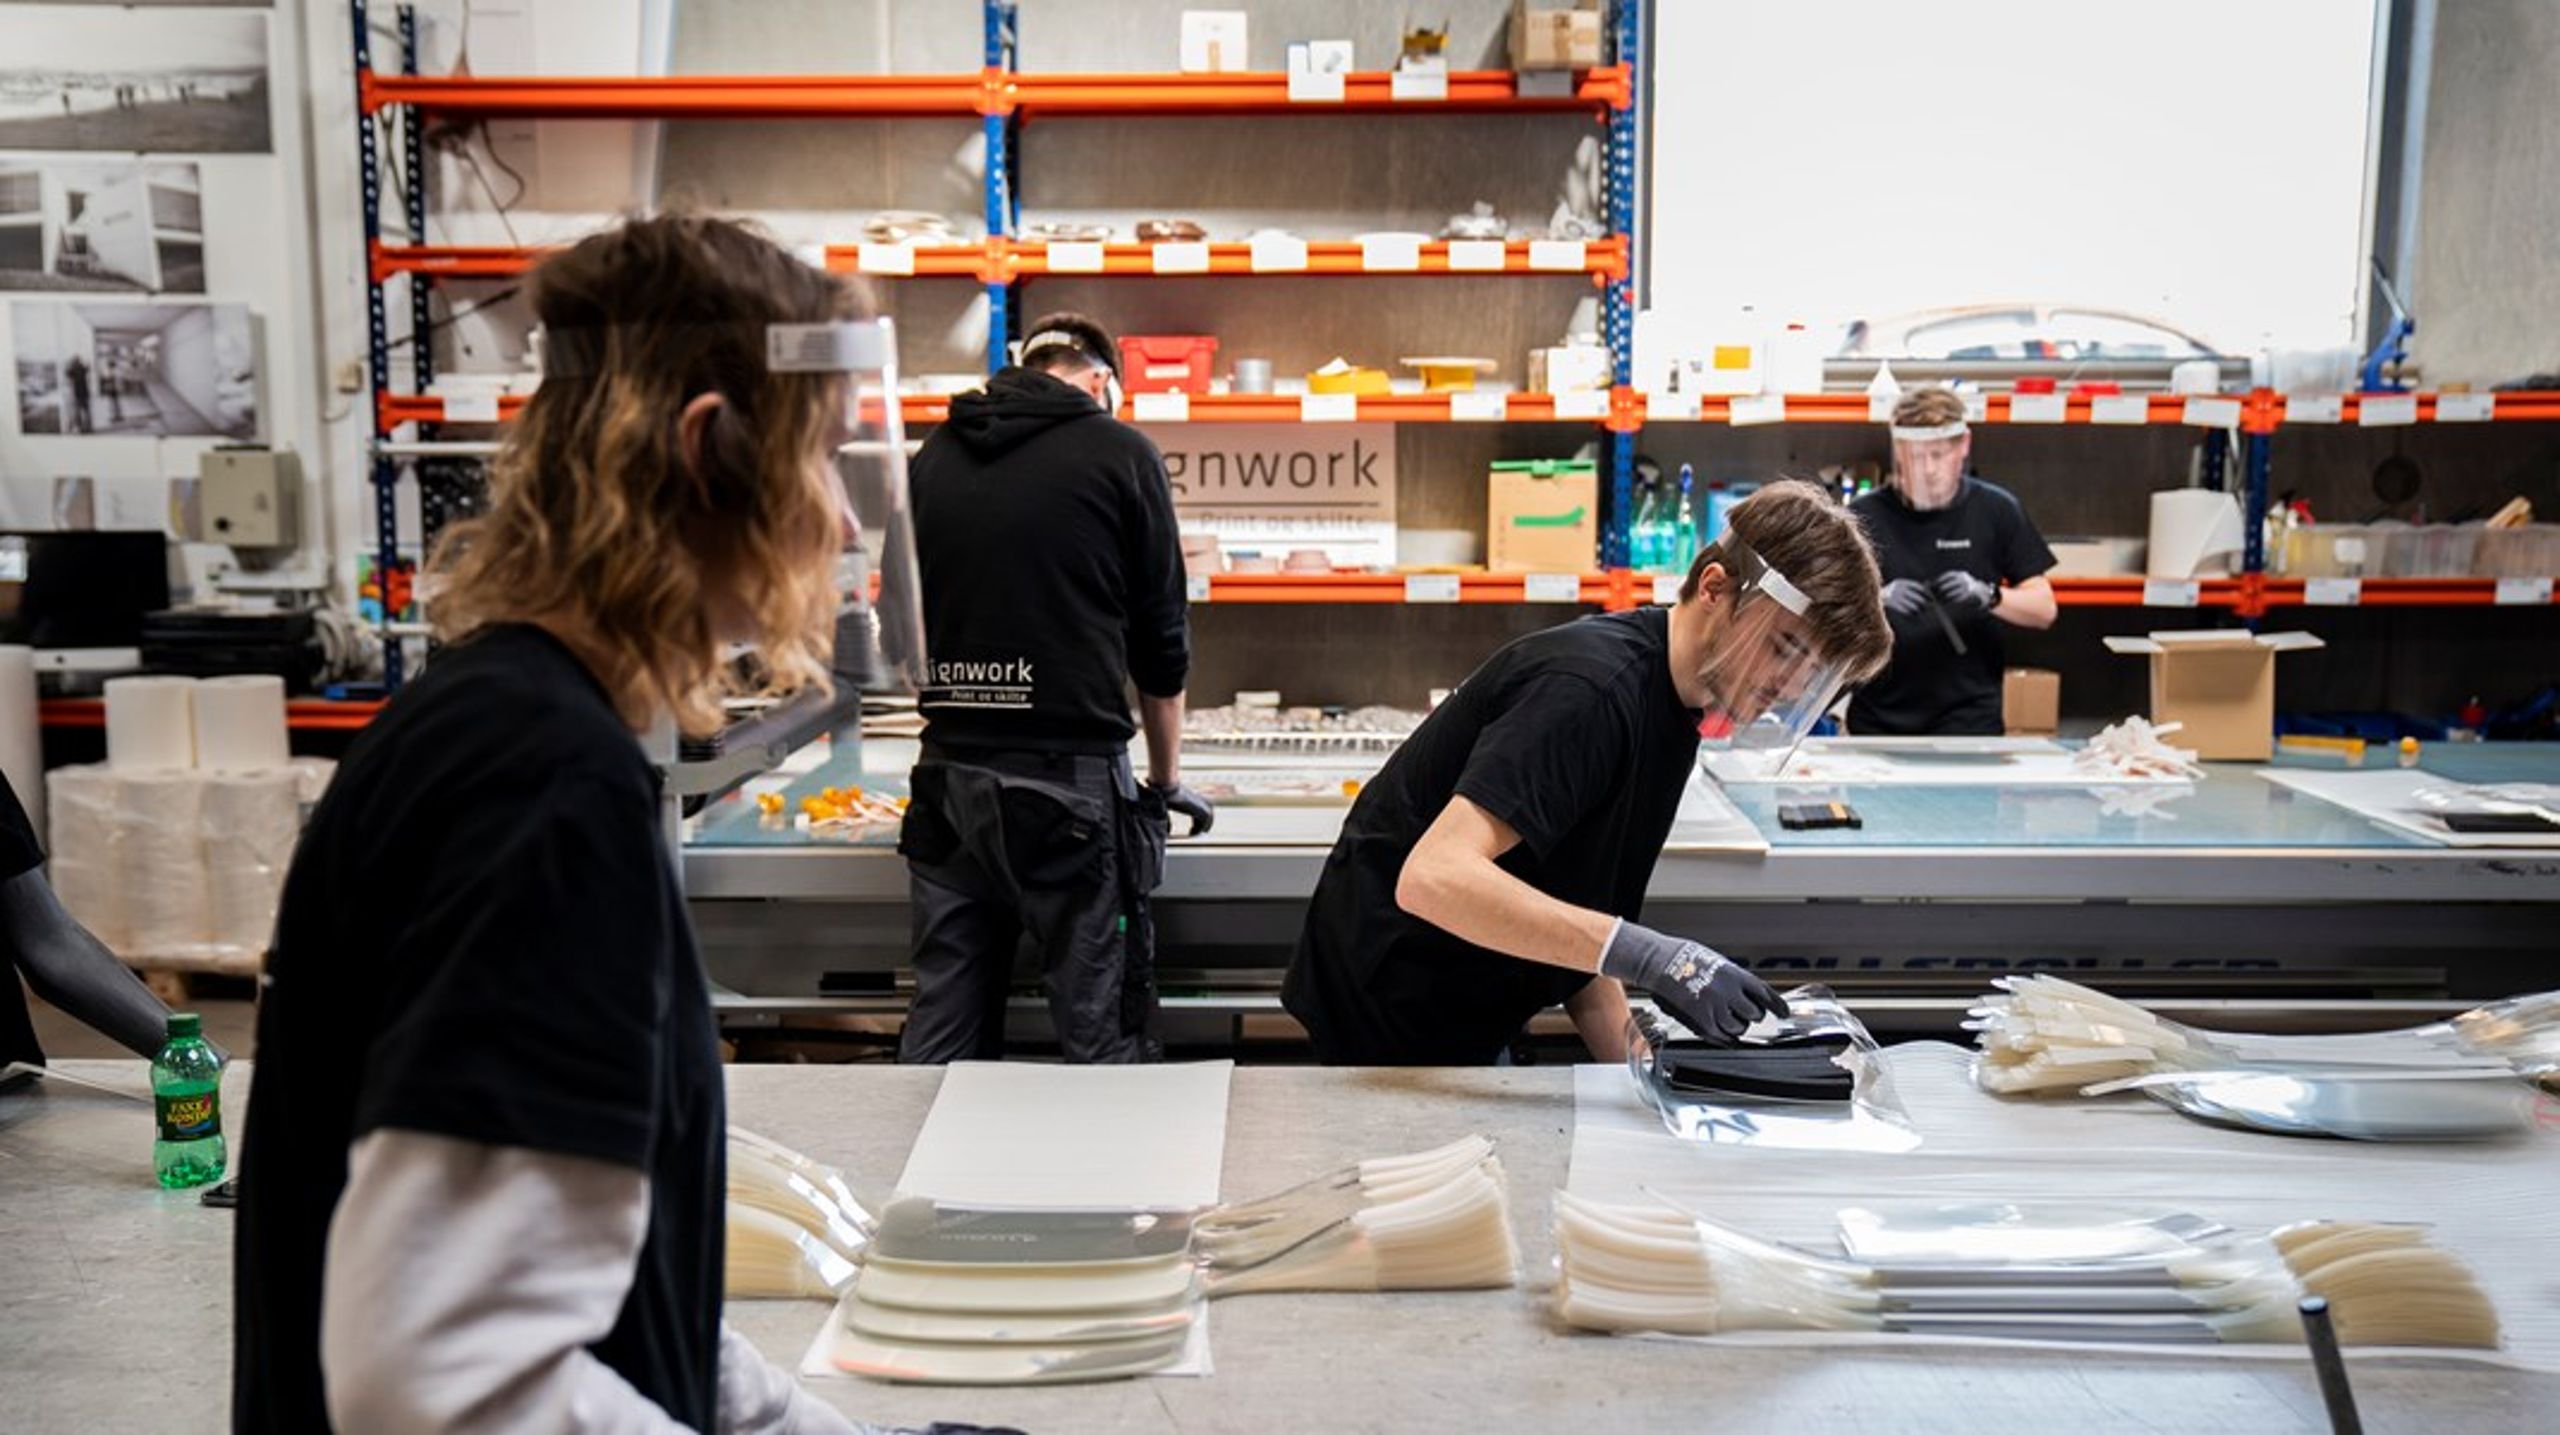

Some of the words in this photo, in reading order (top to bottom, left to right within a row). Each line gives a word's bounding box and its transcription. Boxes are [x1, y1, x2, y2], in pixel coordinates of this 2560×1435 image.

[1163, 438, 1379, 495] gnwork
[1201, 511, 1256, 532] Print
[928, 657, 1033, 685] ignwork
